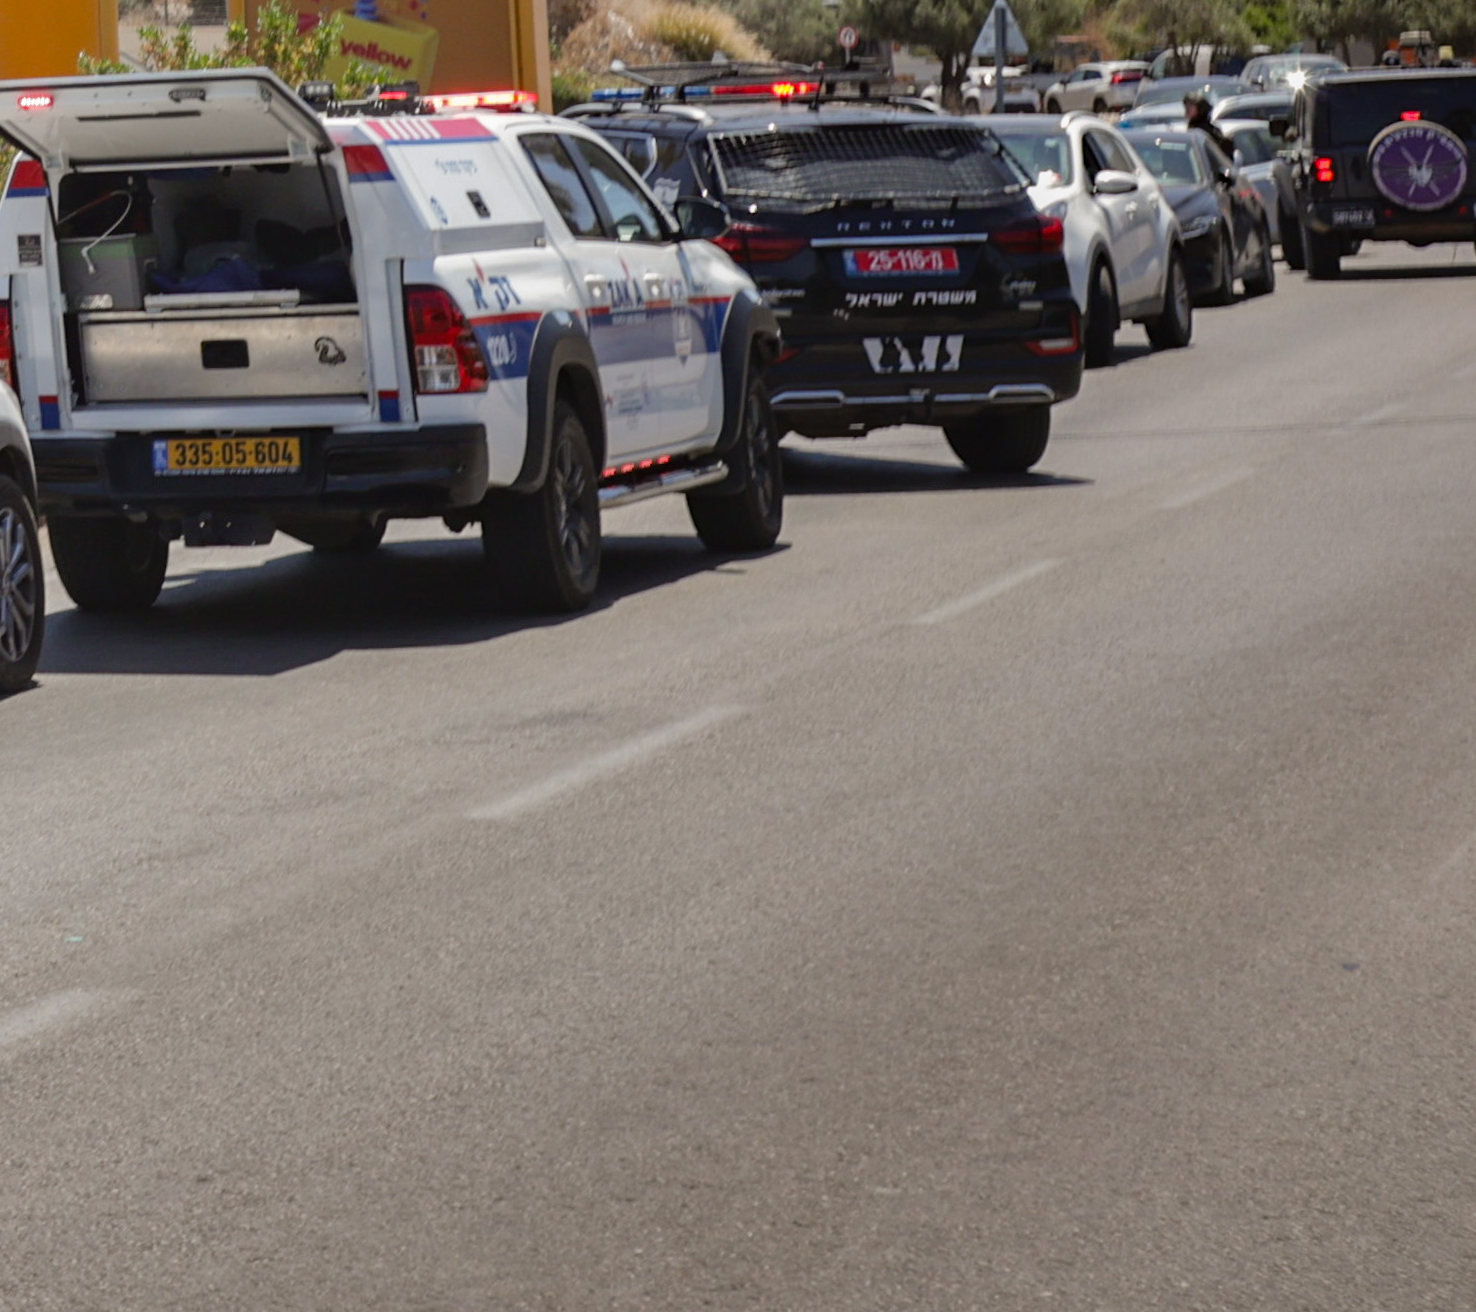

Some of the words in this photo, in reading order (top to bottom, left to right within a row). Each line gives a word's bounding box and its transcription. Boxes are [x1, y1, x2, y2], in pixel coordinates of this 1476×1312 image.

[340, 38, 413, 71] yellow
[846, 292, 903, 307] ישראל
[913, 290, 976, 305] משטרת
